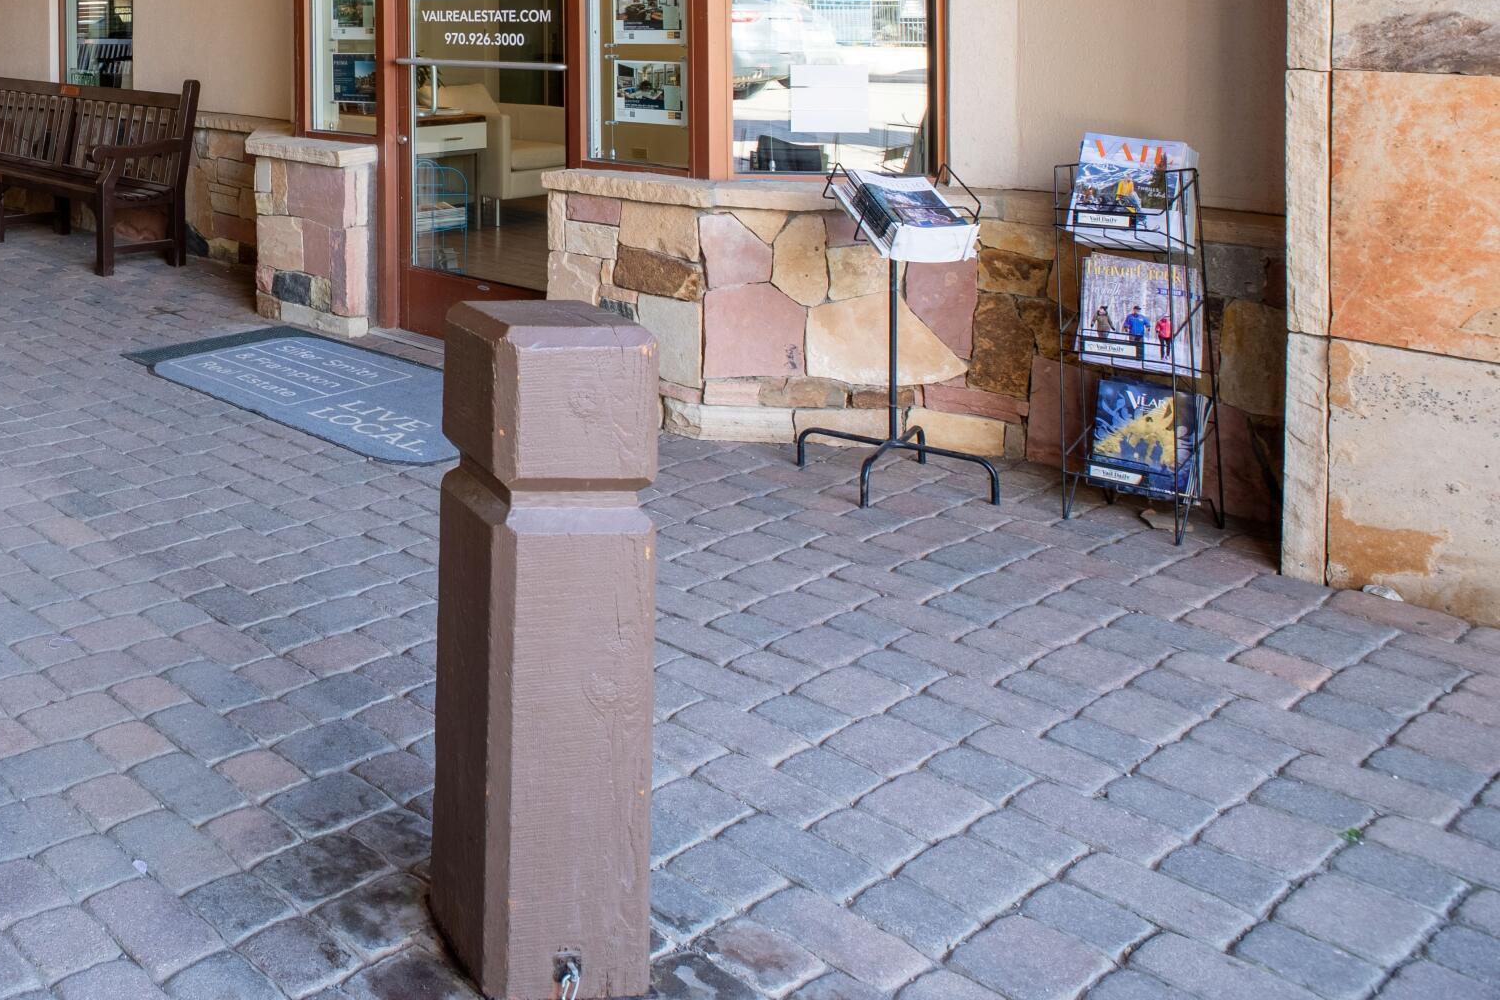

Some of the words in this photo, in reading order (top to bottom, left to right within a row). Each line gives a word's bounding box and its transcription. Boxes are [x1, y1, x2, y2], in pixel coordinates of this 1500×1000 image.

[421, 9, 551, 23] VAILREALESTATE.COM
[444, 32, 525, 46] 970.926.3000
[235, 352, 255, 361] &
[252, 357, 341, 388] Frampton
[275, 345, 324, 361] Slifer
[322, 359, 379, 379] Smith
[198, 361, 240, 376] Real
[236, 371, 298, 398] Estate
[306, 406, 427, 456] LOCAL.
[337, 400, 434, 432] LIVE
